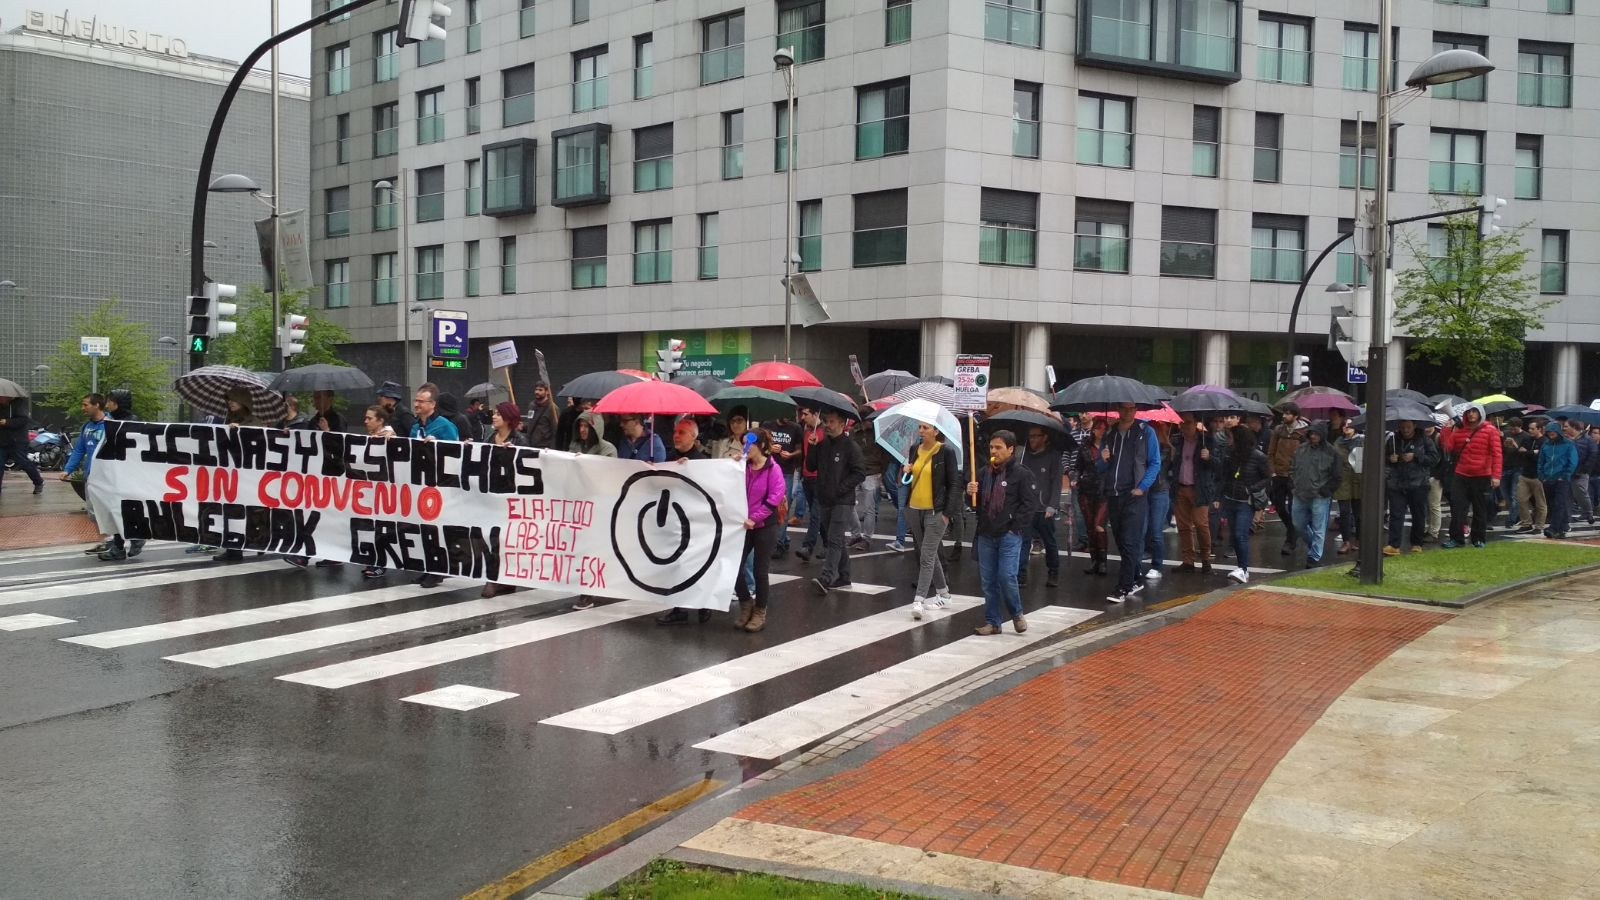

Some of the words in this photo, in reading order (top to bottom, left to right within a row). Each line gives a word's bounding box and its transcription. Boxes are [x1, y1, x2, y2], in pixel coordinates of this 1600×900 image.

[53, 11, 188, 58] DEUSTO
[439, 320, 457, 342] P
[690, 359, 712, 369] negocio
[163, 465, 239, 503] SIN
[258, 470, 443, 522] CONVENIO
[349, 517, 501, 581] GREBAN
